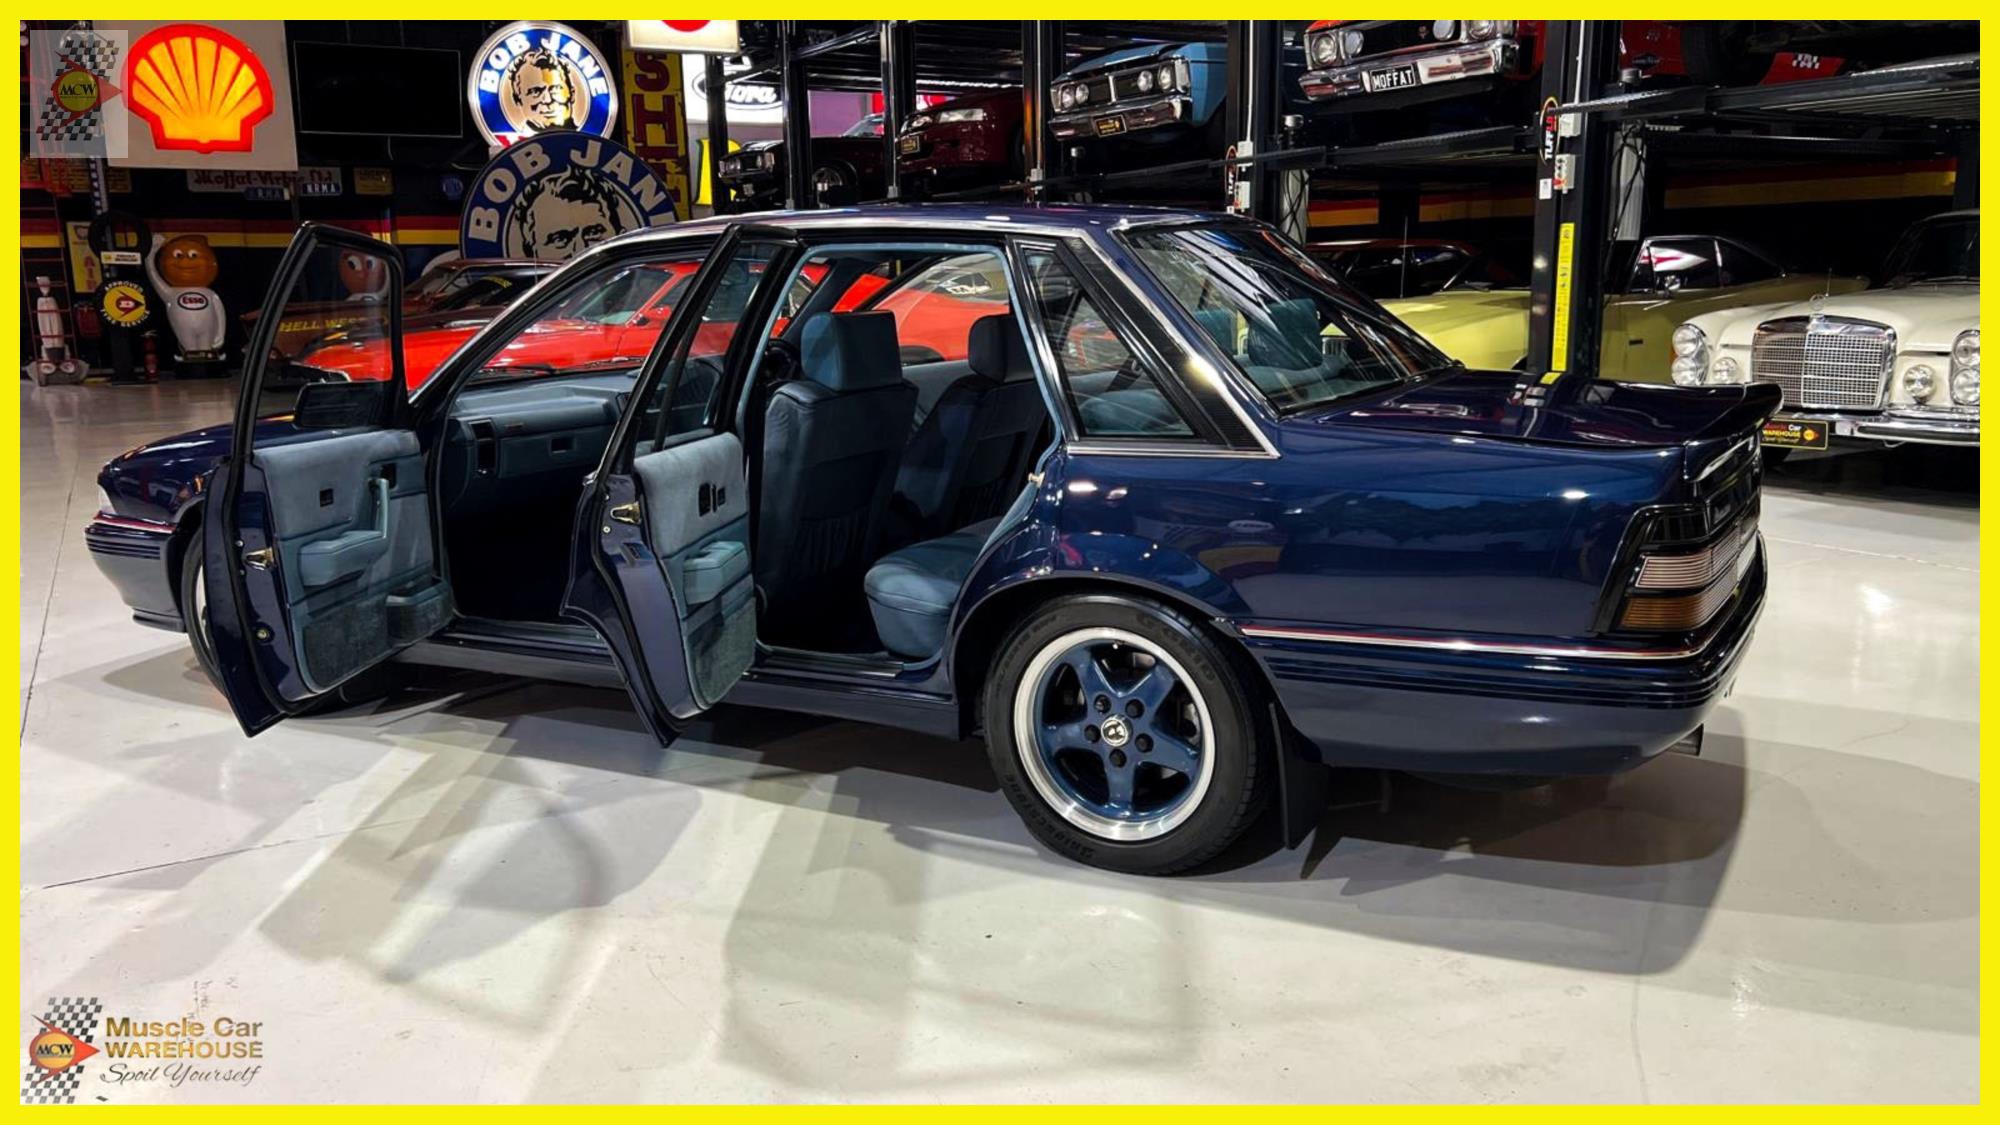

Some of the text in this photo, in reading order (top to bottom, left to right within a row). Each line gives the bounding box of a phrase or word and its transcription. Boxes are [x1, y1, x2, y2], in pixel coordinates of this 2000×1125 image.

[479, 31, 609, 98] BOB JANE
[1372, 69, 1412, 89] MOFFAT
[306, 183, 336, 194] NRMA
[467, 142, 552, 243] BOB
